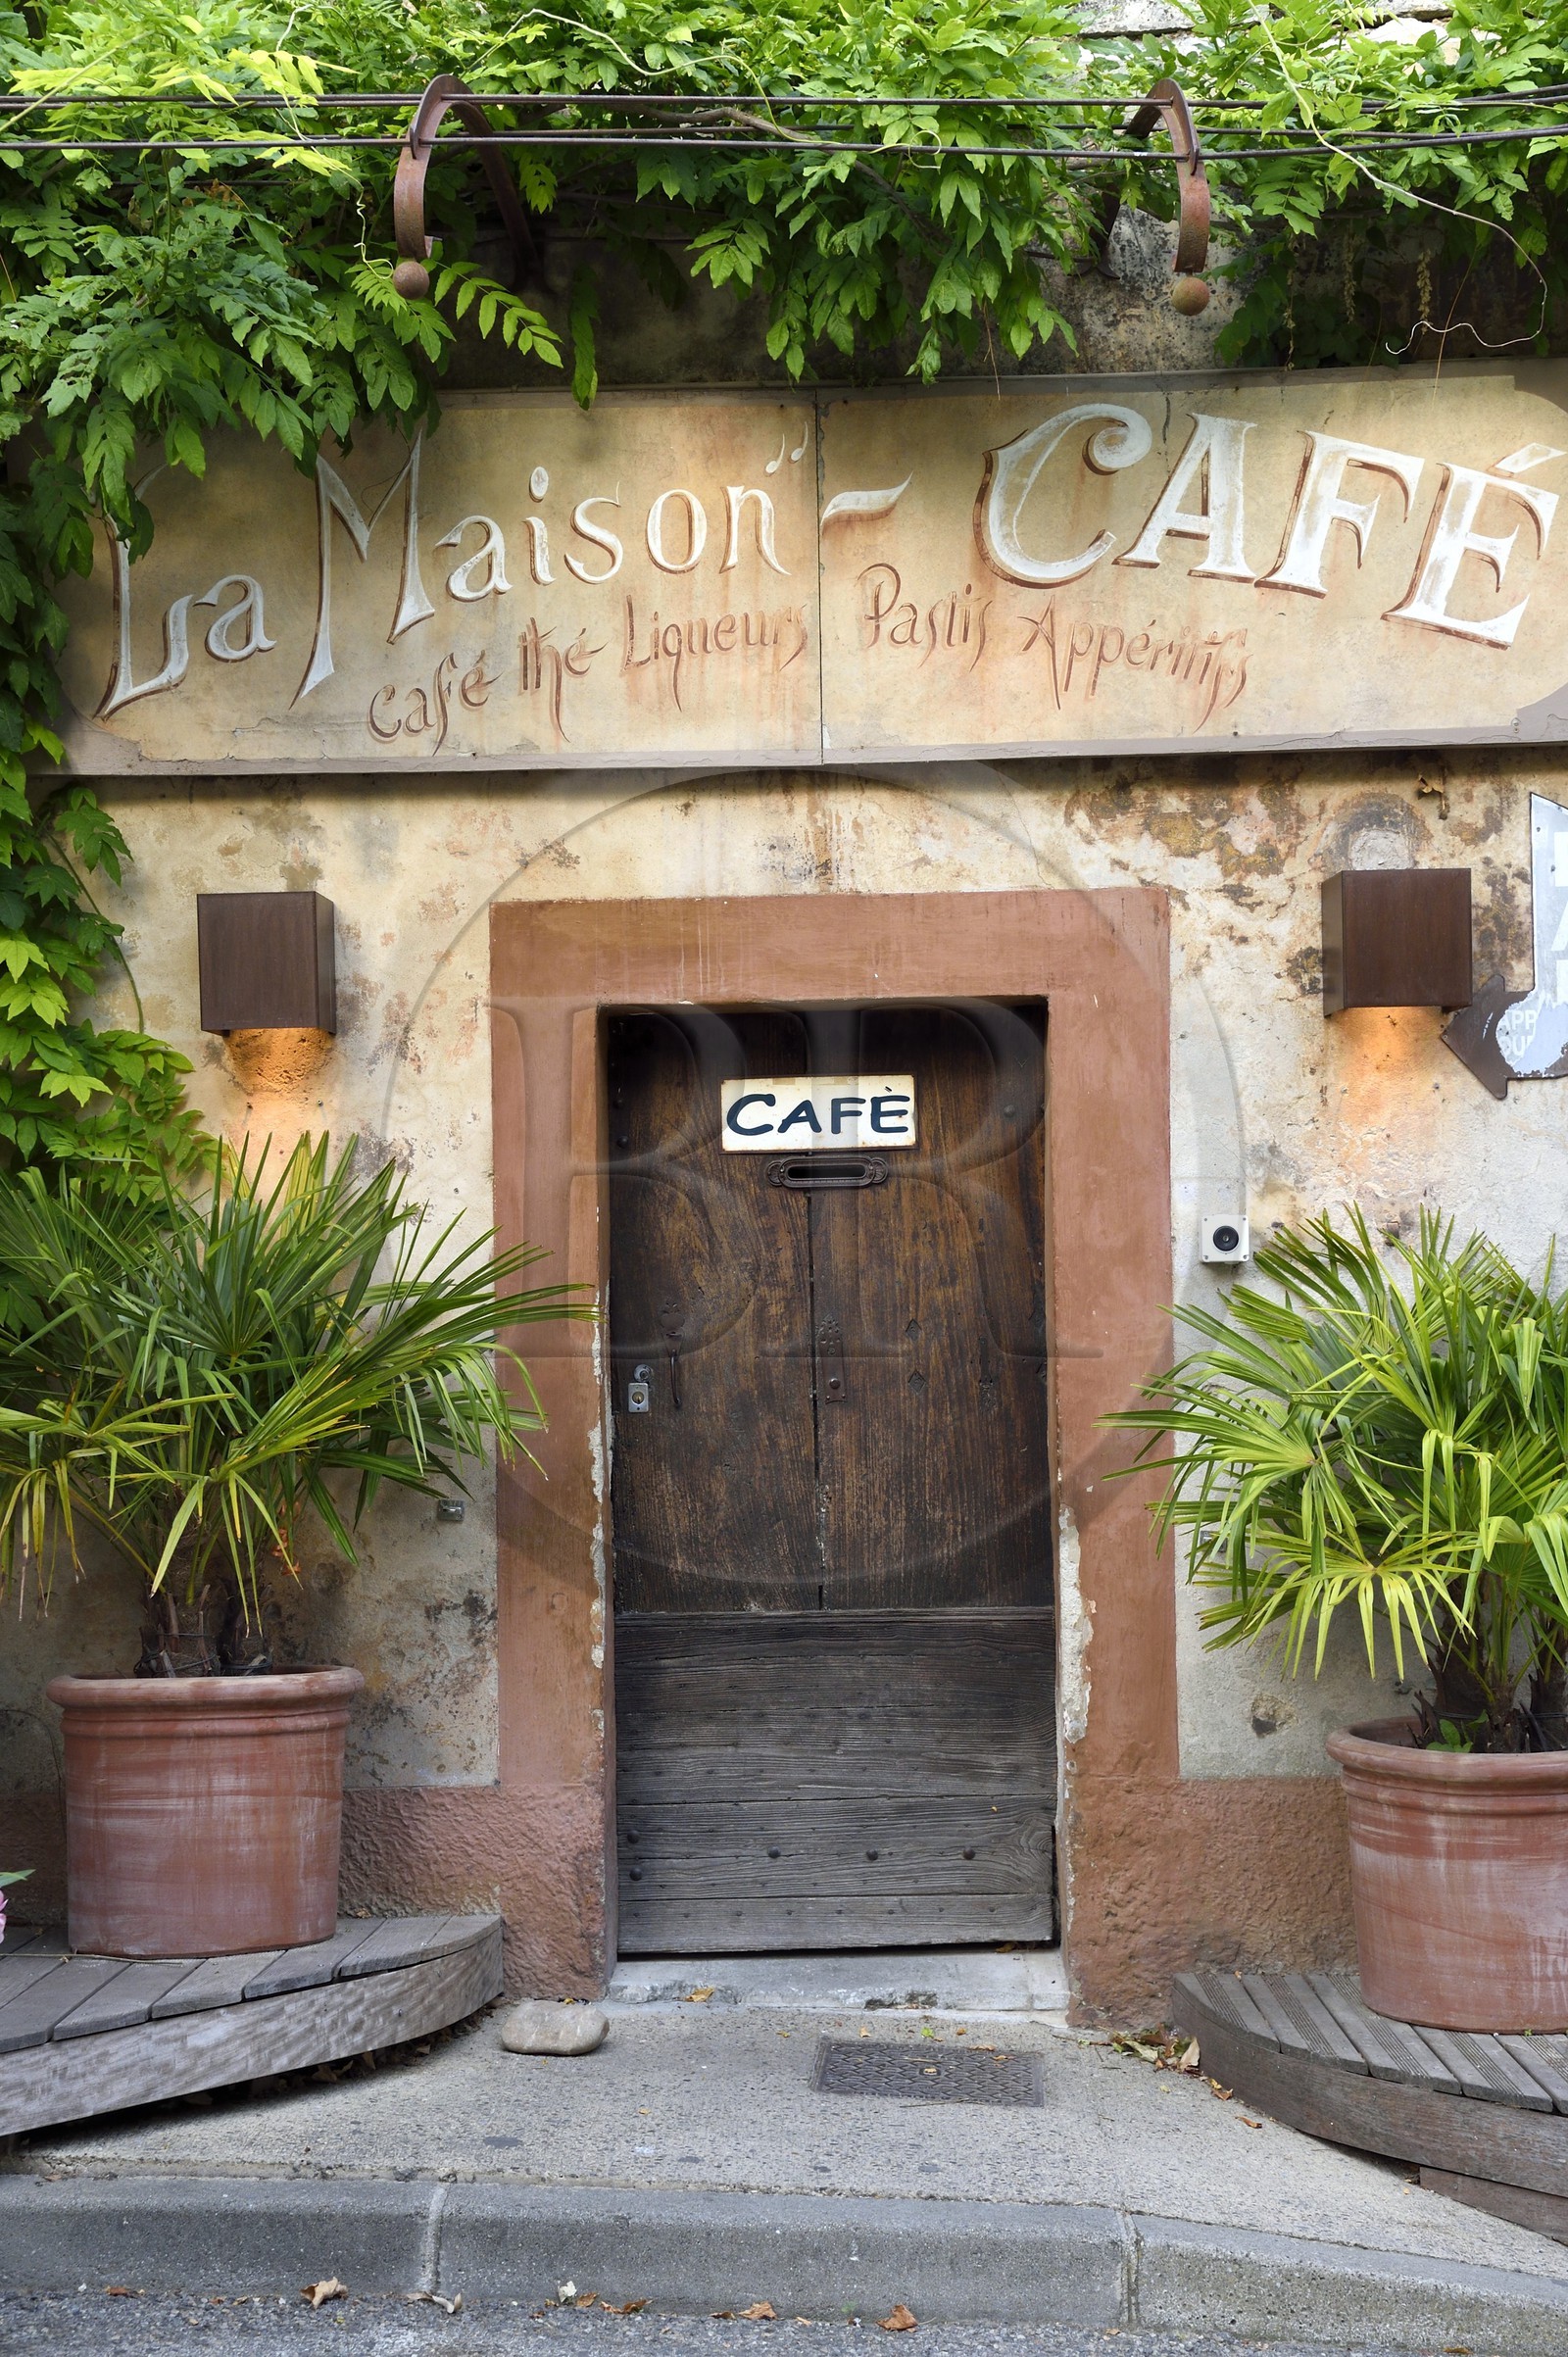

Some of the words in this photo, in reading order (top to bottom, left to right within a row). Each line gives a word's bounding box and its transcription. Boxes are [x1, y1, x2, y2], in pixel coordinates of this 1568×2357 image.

[90, 463, 277, 722] La
[289, 425, 793, 712] Maison
[973, 403, 1567, 650] CAFÉ
[517, 617, 608, 743] thé
[620, 595, 808, 712] Liqueurs
[855, 564, 993, 672] Pastis
